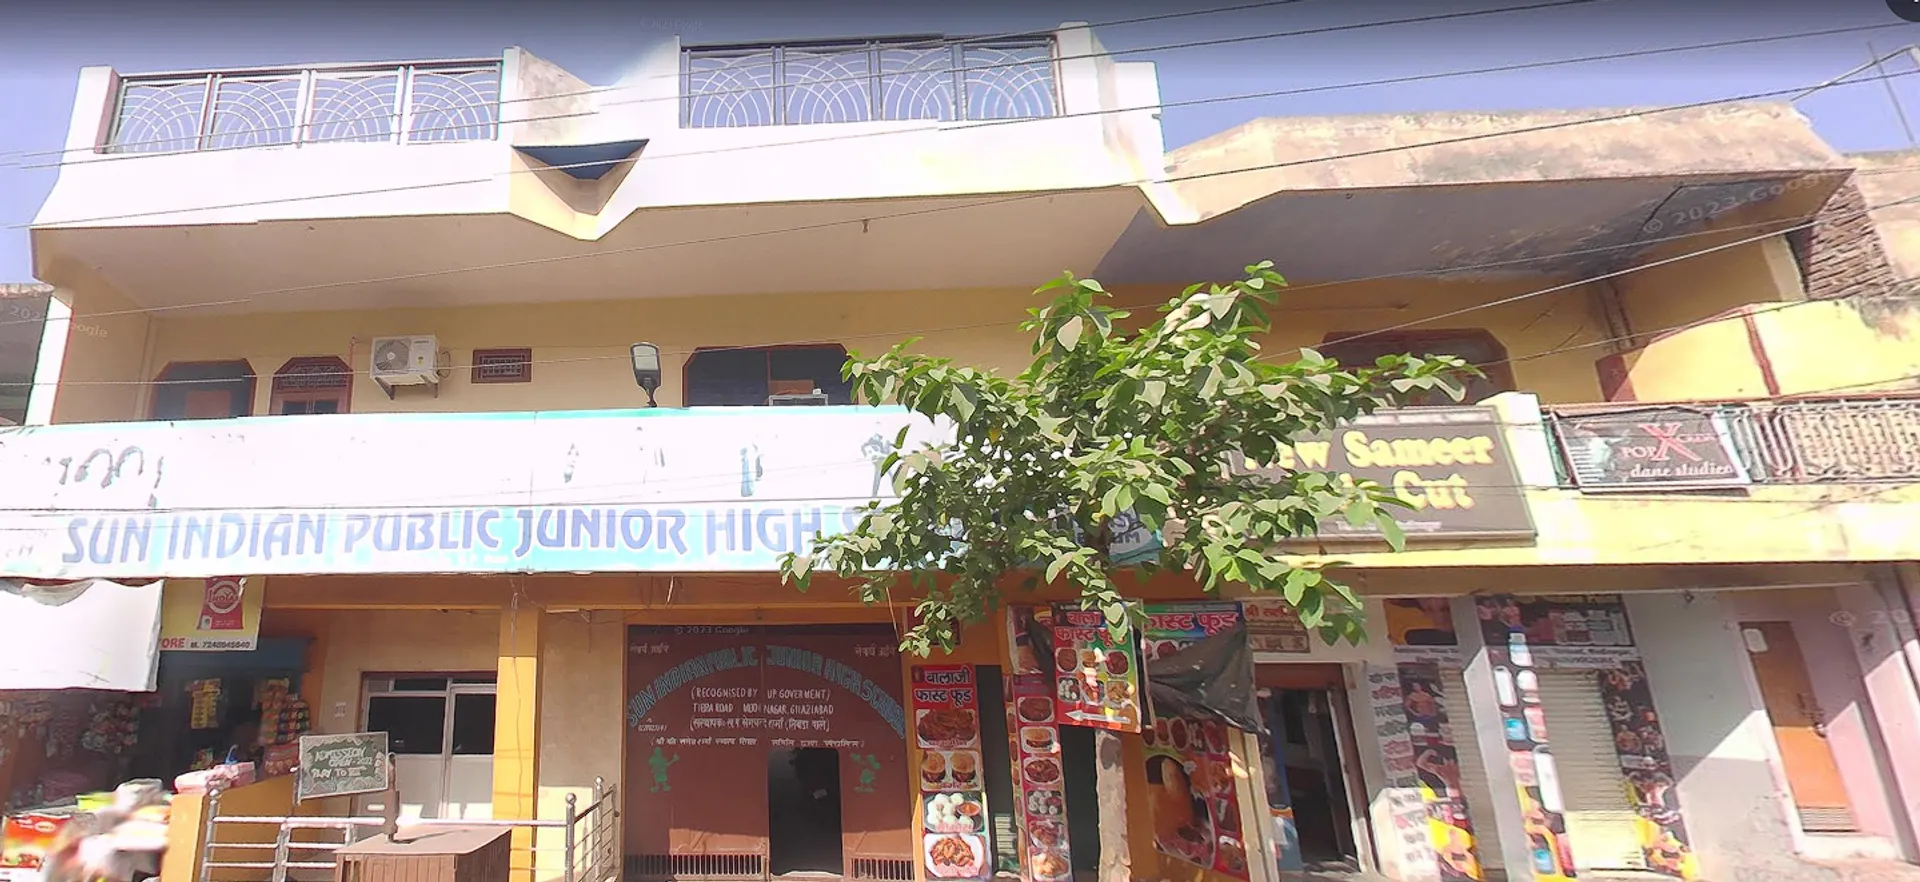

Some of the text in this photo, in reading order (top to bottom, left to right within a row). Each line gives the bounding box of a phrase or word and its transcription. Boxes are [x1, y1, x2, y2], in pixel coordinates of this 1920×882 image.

[1342, 430, 1494, 469] Sameer
[1637, 422, 1703, 462] X
[1392, 469, 1475, 510] Cut
[62, 515, 152, 564] SUN
[168, 511, 326, 562] INDIAN
[344, 509, 499, 554] PUBLIC
[515, 509, 688, 557] JUNIOR
[706, 508, 822, 556] HIGH
[914, 688, 949, 702] फास्ट
